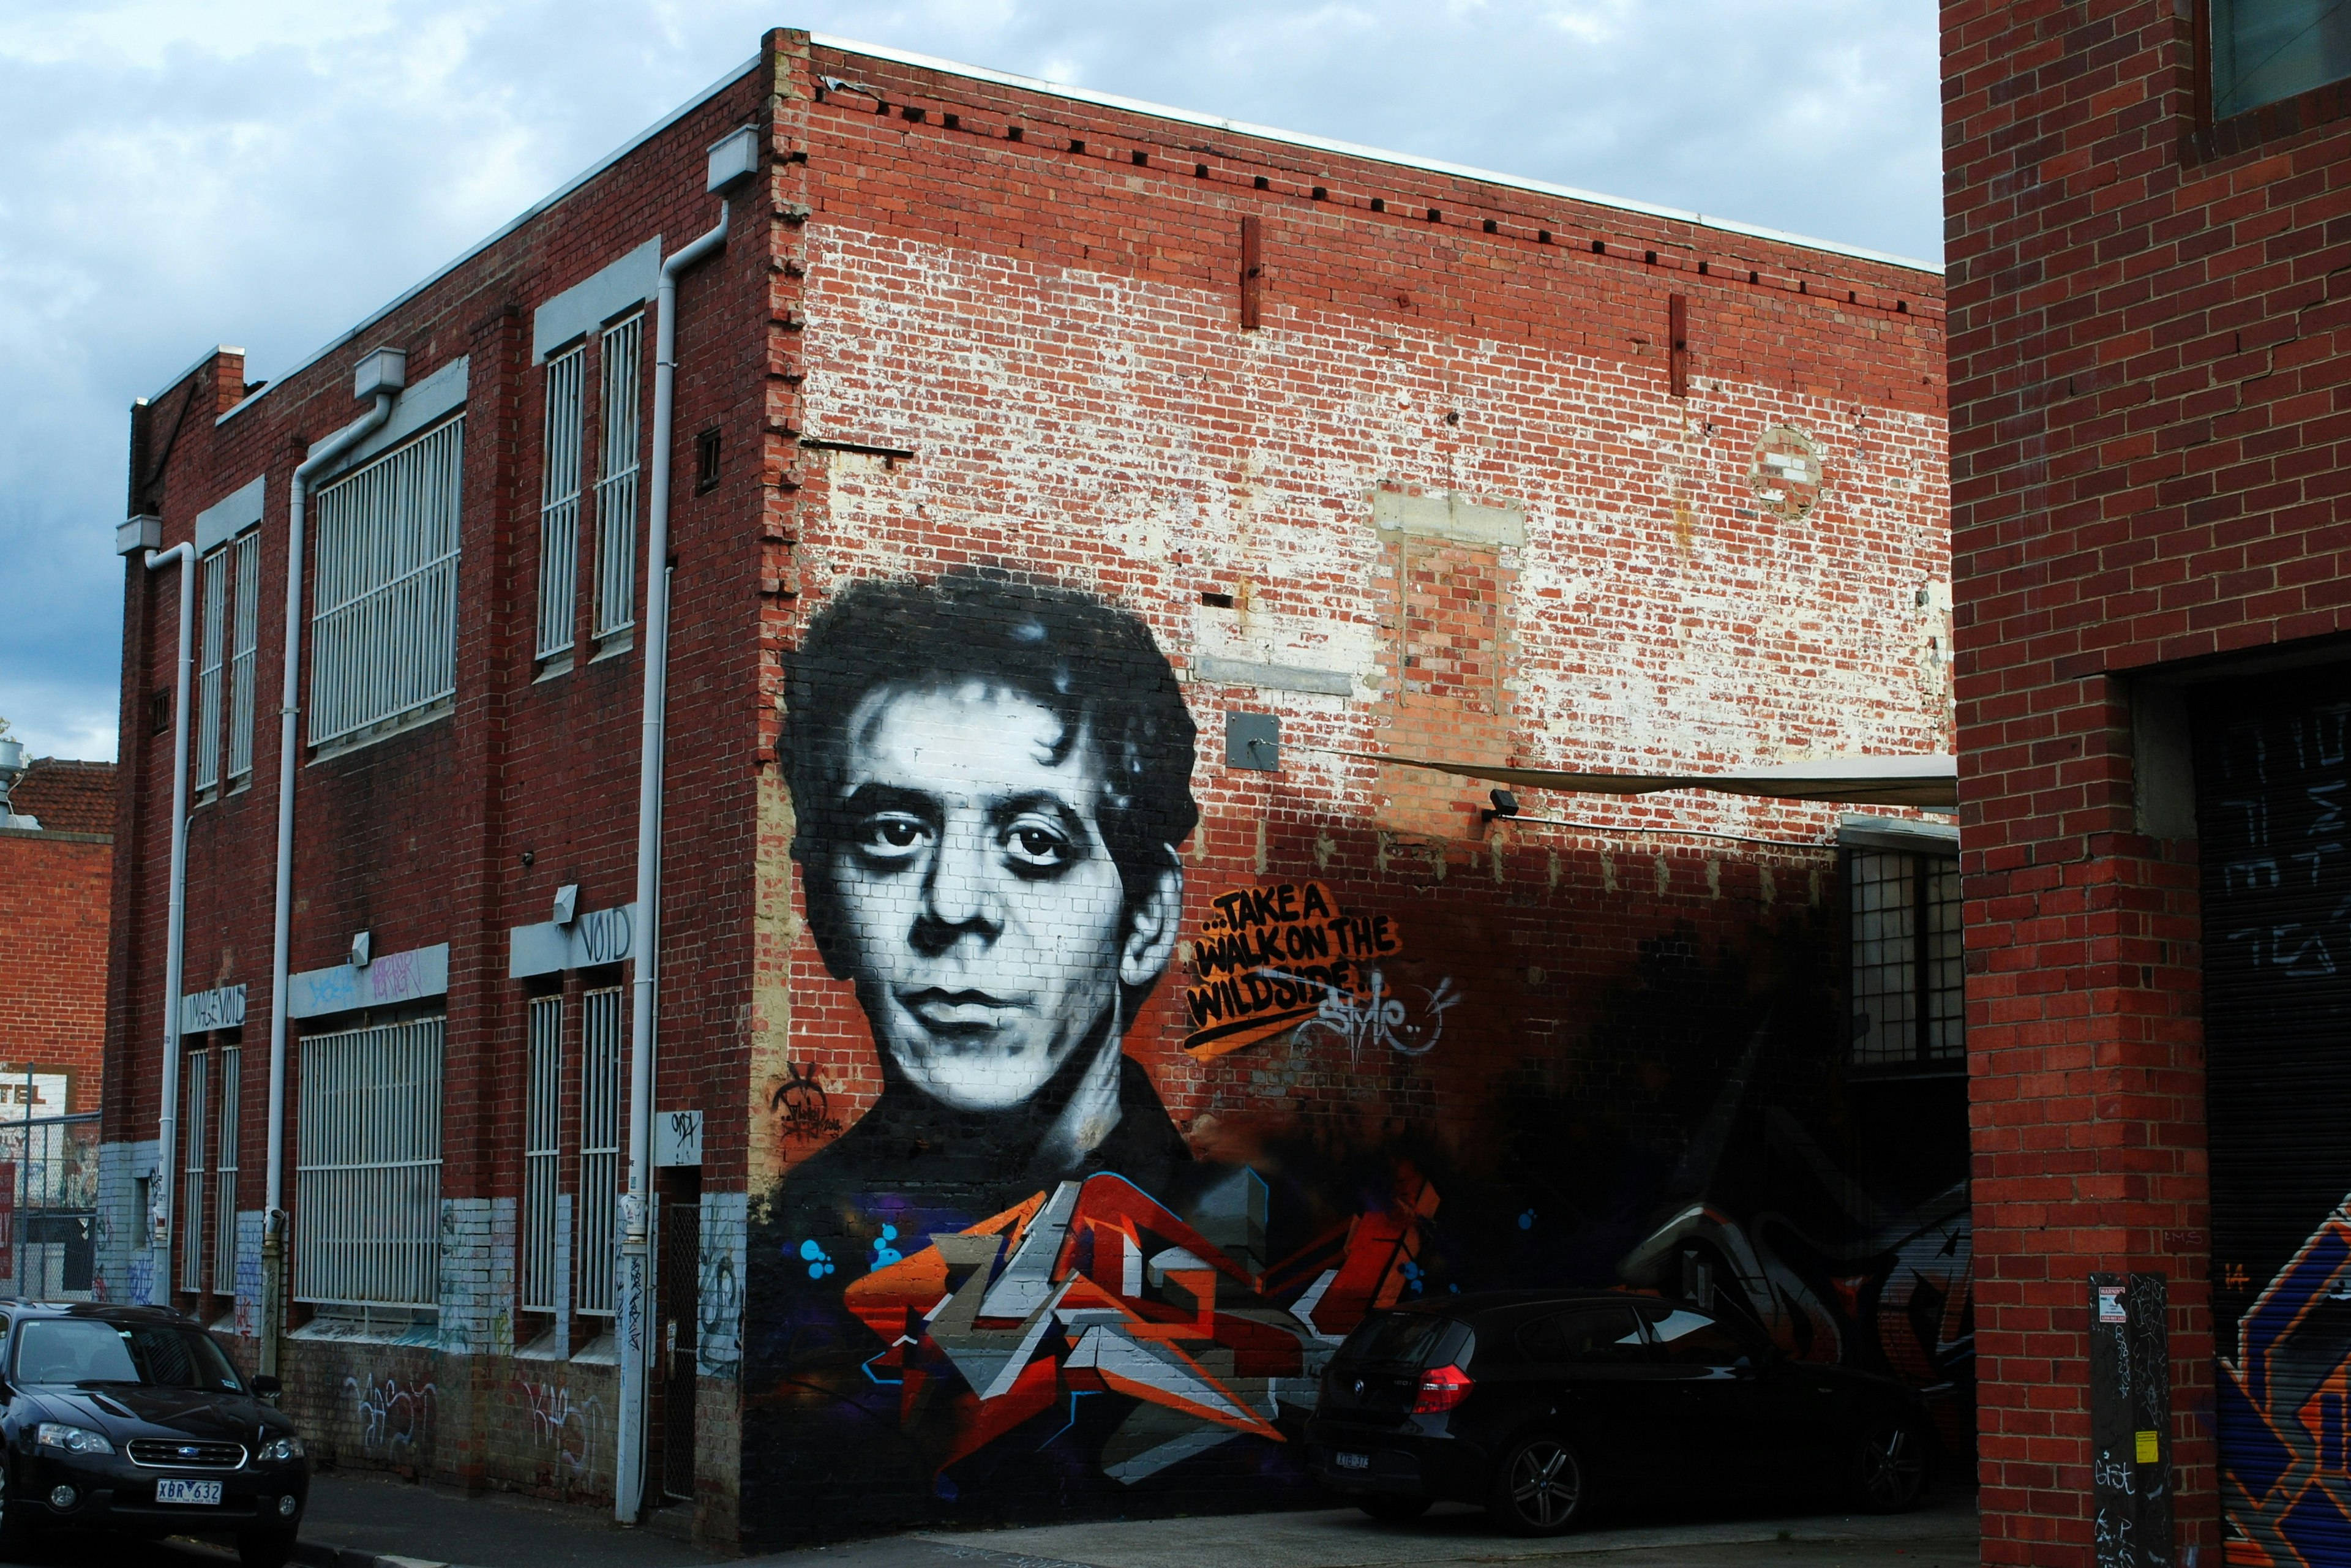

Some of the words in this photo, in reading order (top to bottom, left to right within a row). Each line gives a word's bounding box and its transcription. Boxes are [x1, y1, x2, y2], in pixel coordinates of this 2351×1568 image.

[1303, 883, 1329, 919] A
[577, 906, 631, 962] VOID
[1195, 927, 1286, 978] WALK
[1286, 925, 1329, 961] ON
[1328, 915, 1396, 956] THE
[219, 985, 246, 1025] VOID
[1187, 973, 1273, 1027] WILD
[159, 1482, 184, 1498] XBR
[194, 1485, 219, 1499] 632
